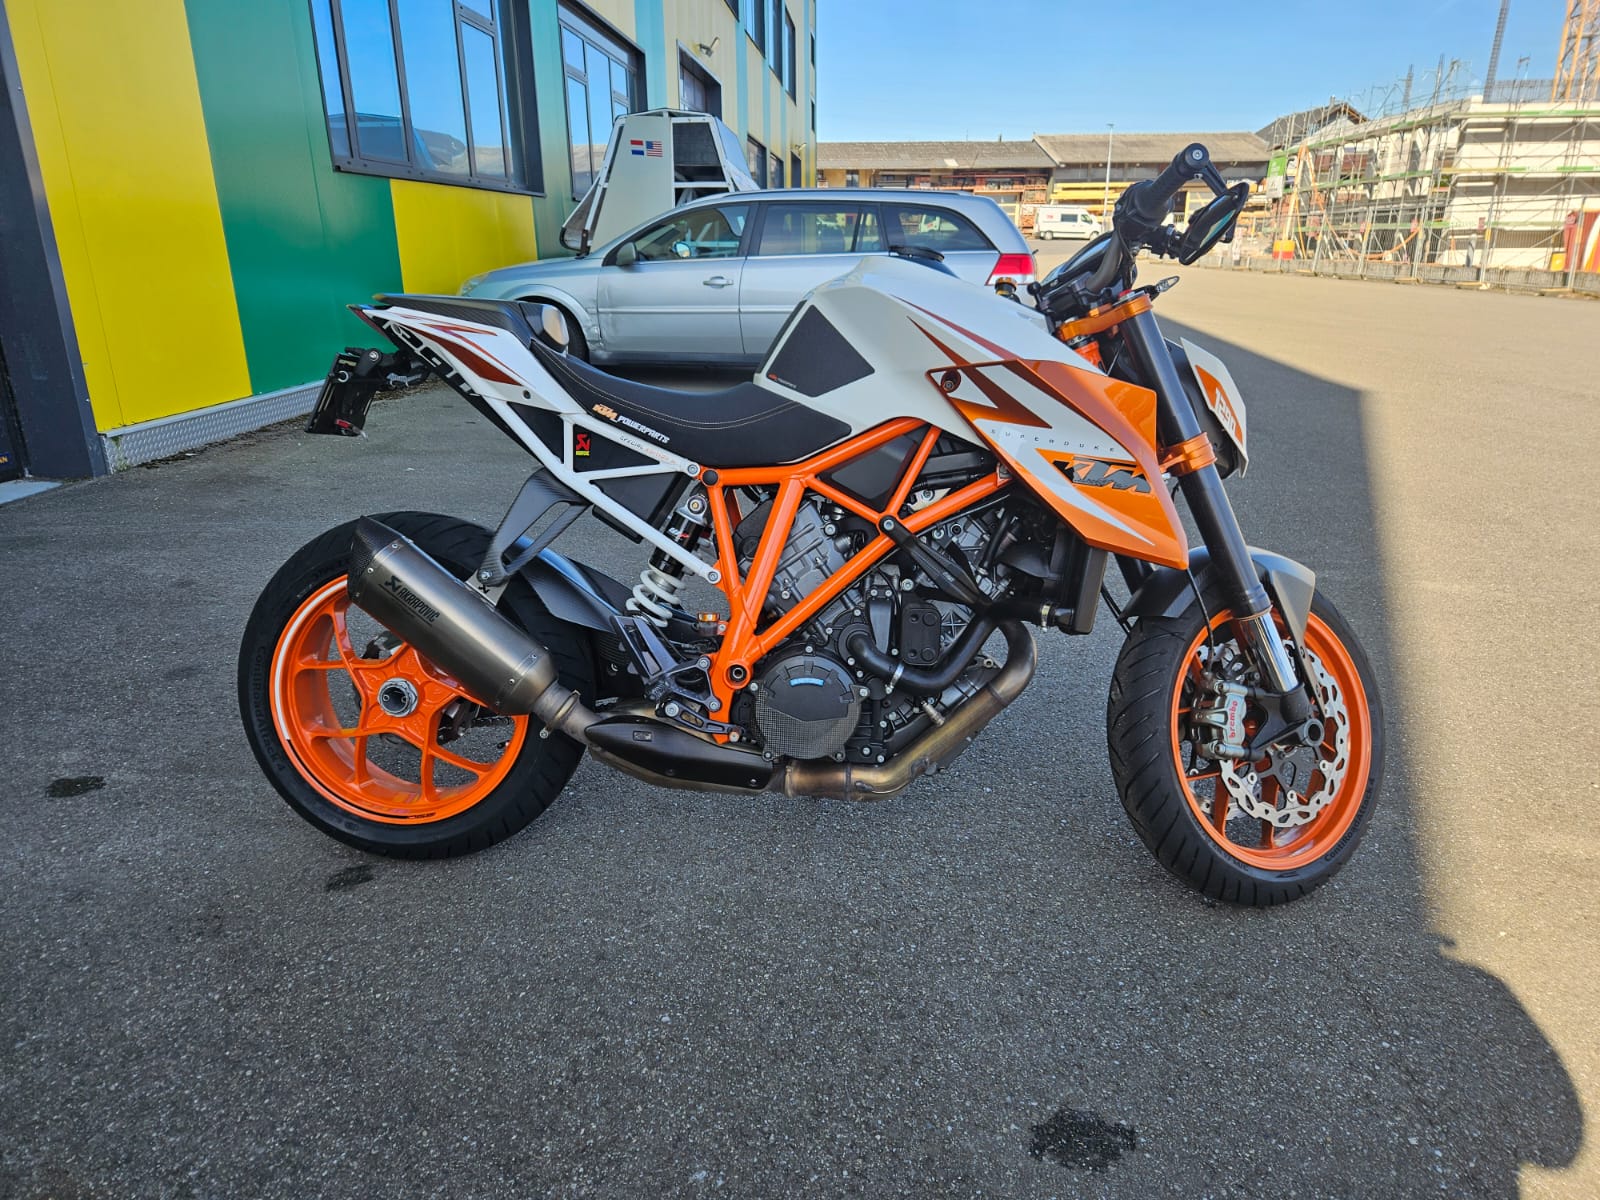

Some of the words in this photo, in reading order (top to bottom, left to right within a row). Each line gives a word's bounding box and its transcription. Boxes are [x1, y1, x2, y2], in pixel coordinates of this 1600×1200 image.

[592, 404, 618, 422] KTM
[617, 415, 670, 443] POWERPARTS
[1052, 455, 1151, 494] KTM
[1229, 700, 1239, 739] brembo
